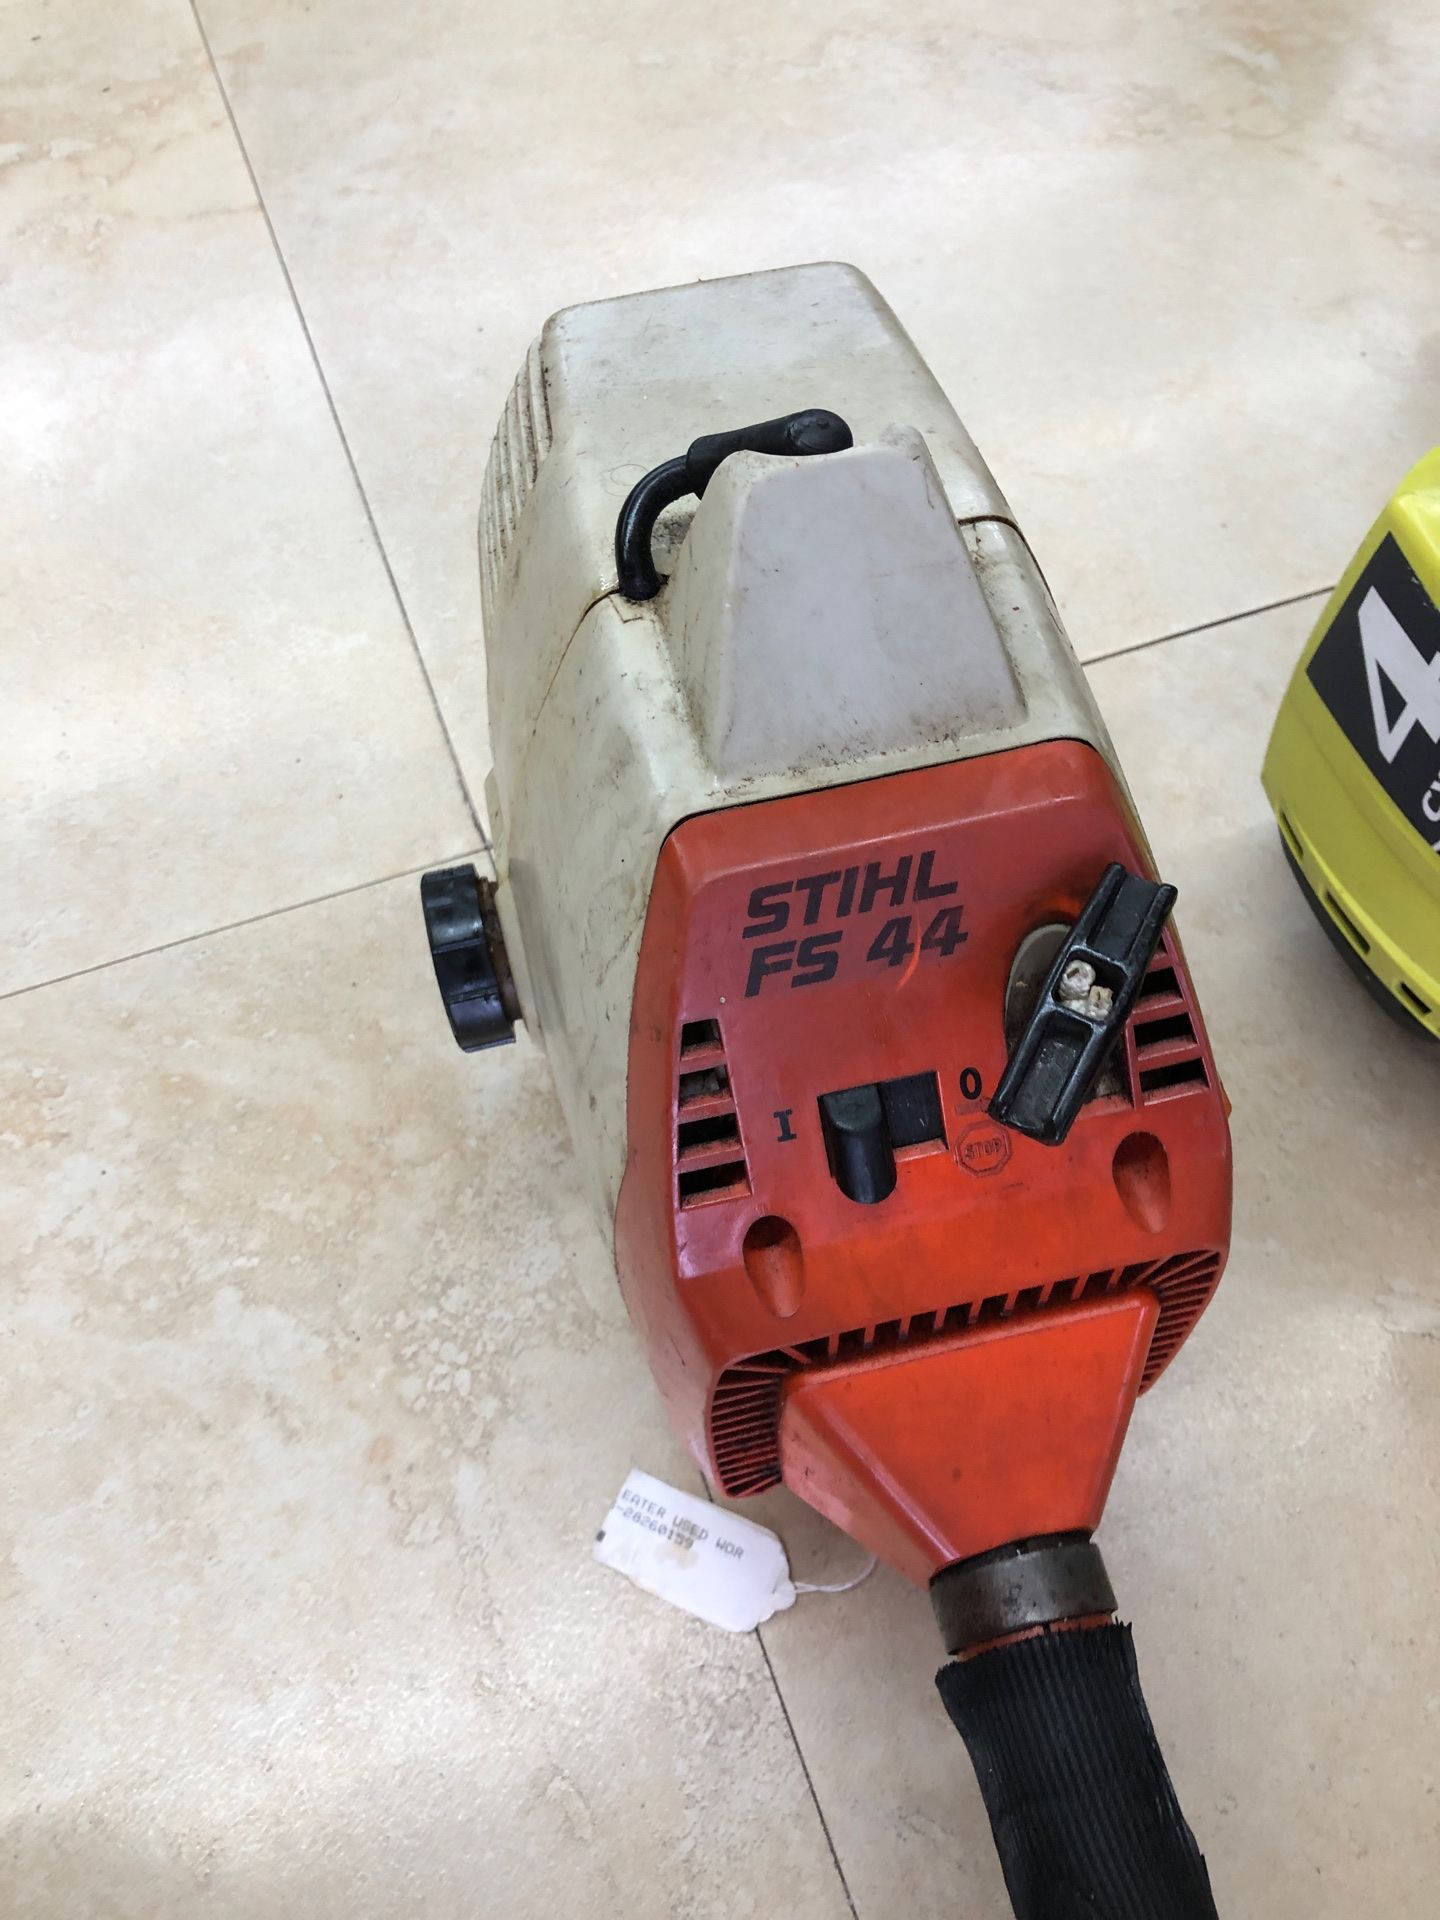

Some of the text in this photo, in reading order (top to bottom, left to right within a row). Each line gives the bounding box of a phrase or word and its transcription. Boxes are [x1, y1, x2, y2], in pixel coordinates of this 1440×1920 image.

[742, 850, 958, 939] STIHL
[745, 905, 968, 998] FS 44
[965, 1137, 1003, 1160] STOP
[622, 1488, 667, 1519] EATER
[673, 1515, 709, 1541] USED
